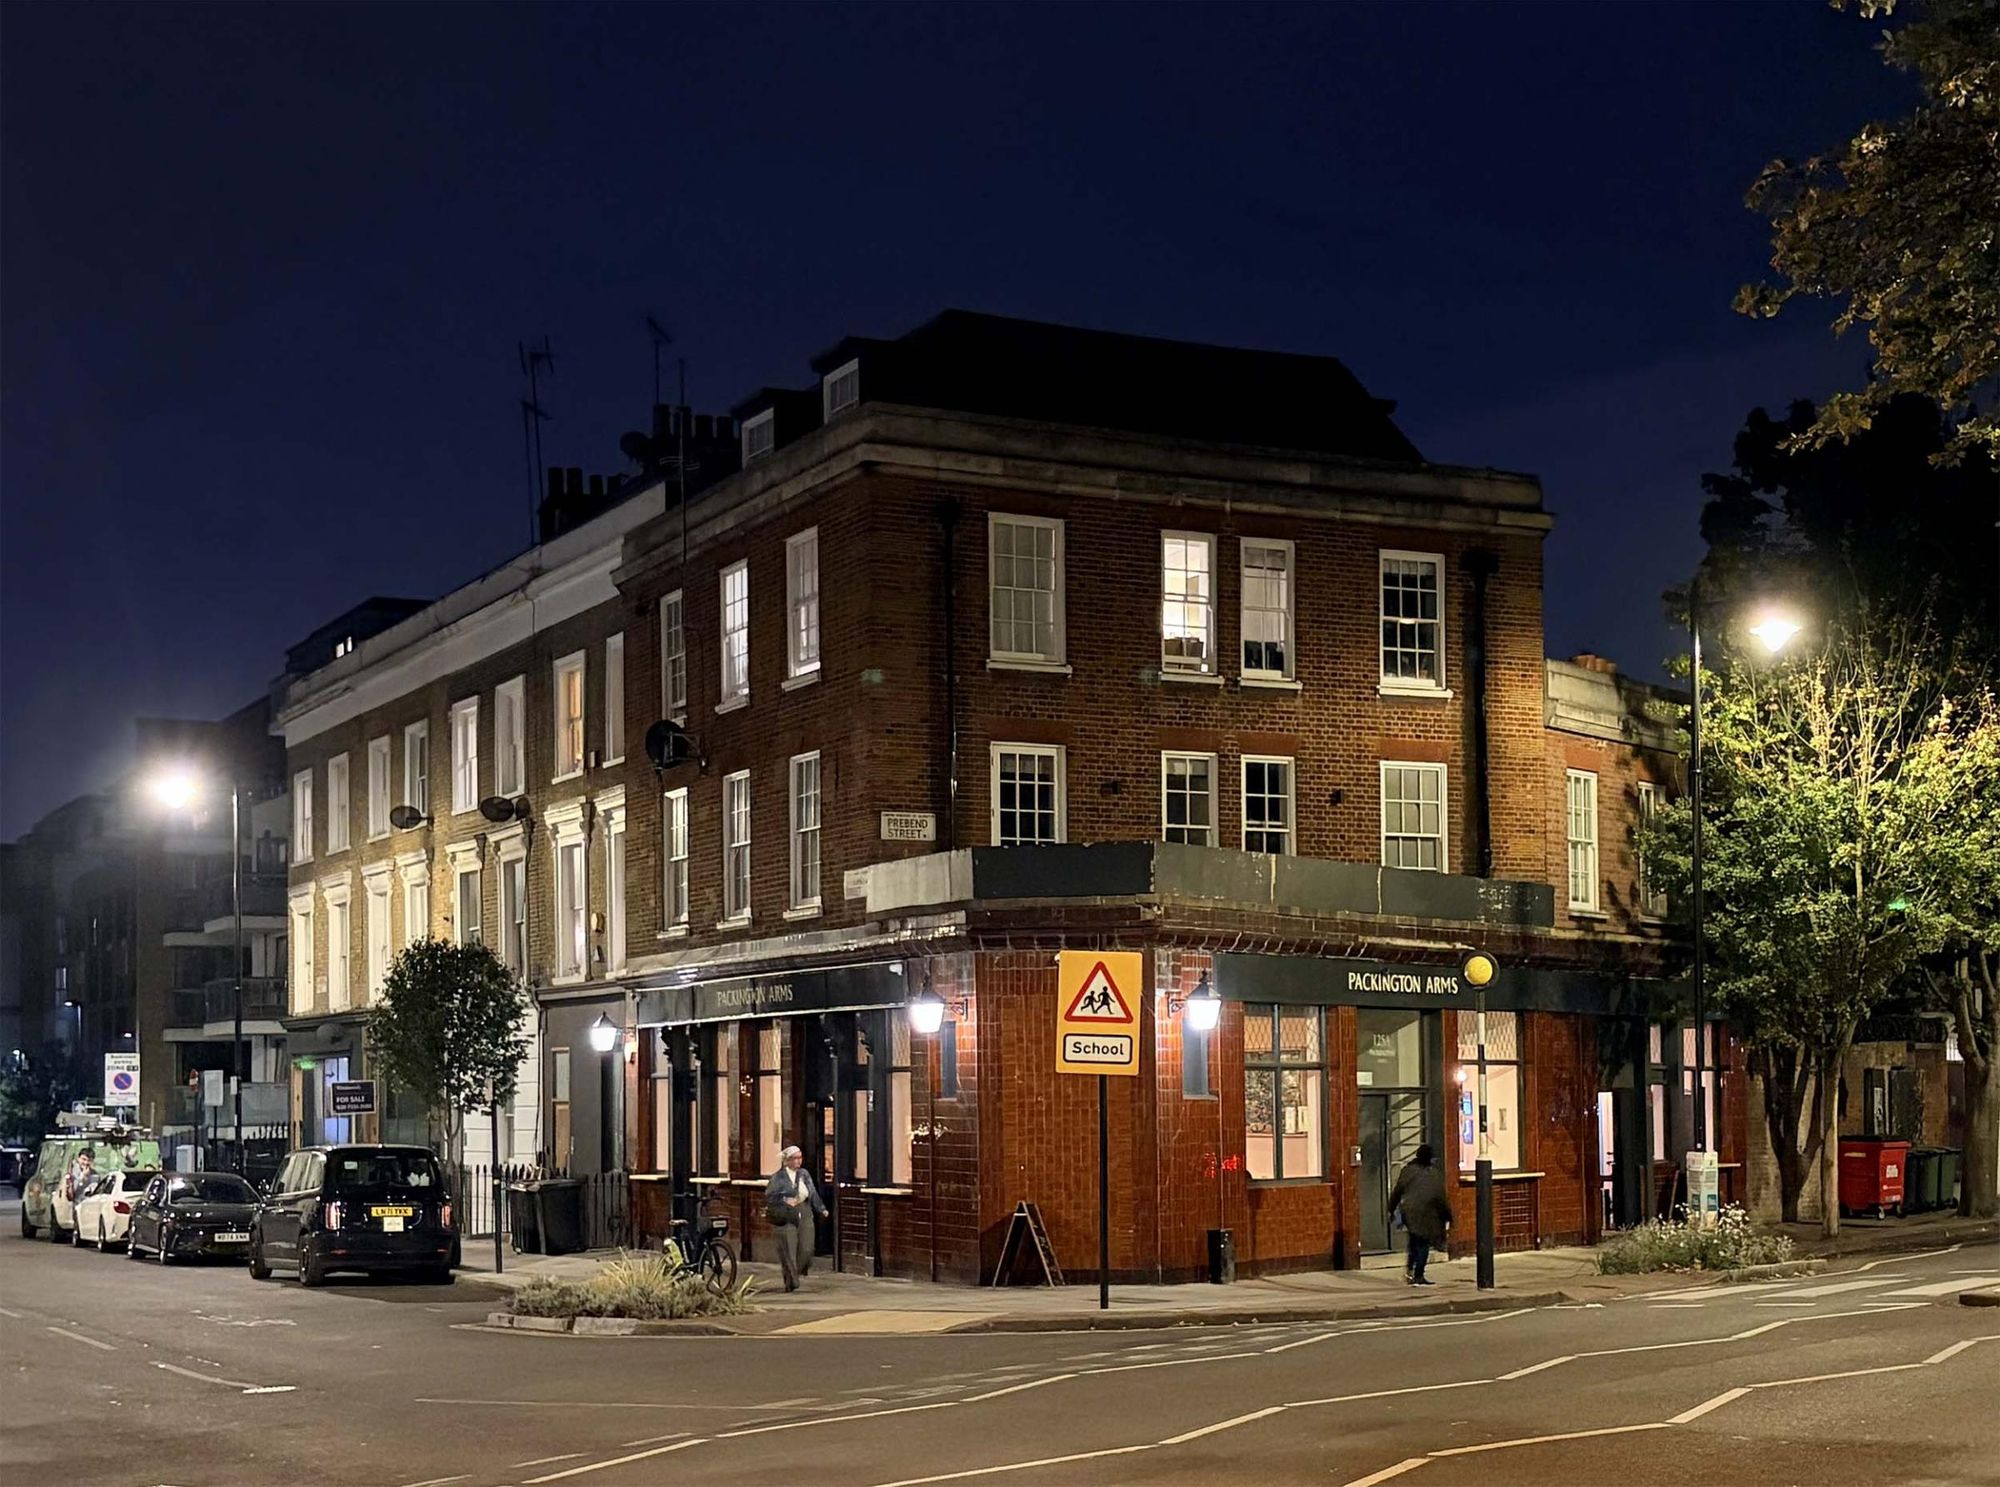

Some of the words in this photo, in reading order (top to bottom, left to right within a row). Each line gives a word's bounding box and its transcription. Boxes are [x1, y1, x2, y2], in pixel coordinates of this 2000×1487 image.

[887, 818, 928, 829] PREBEND
[1348, 972, 1421, 993] PACKINGTON
[1425, 976, 1459, 994] ARMS
[717, 986, 766, 1007] PACKINGTON
[769, 984, 793, 1003] ARMS
[1072, 1041, 1124, 1056] School
